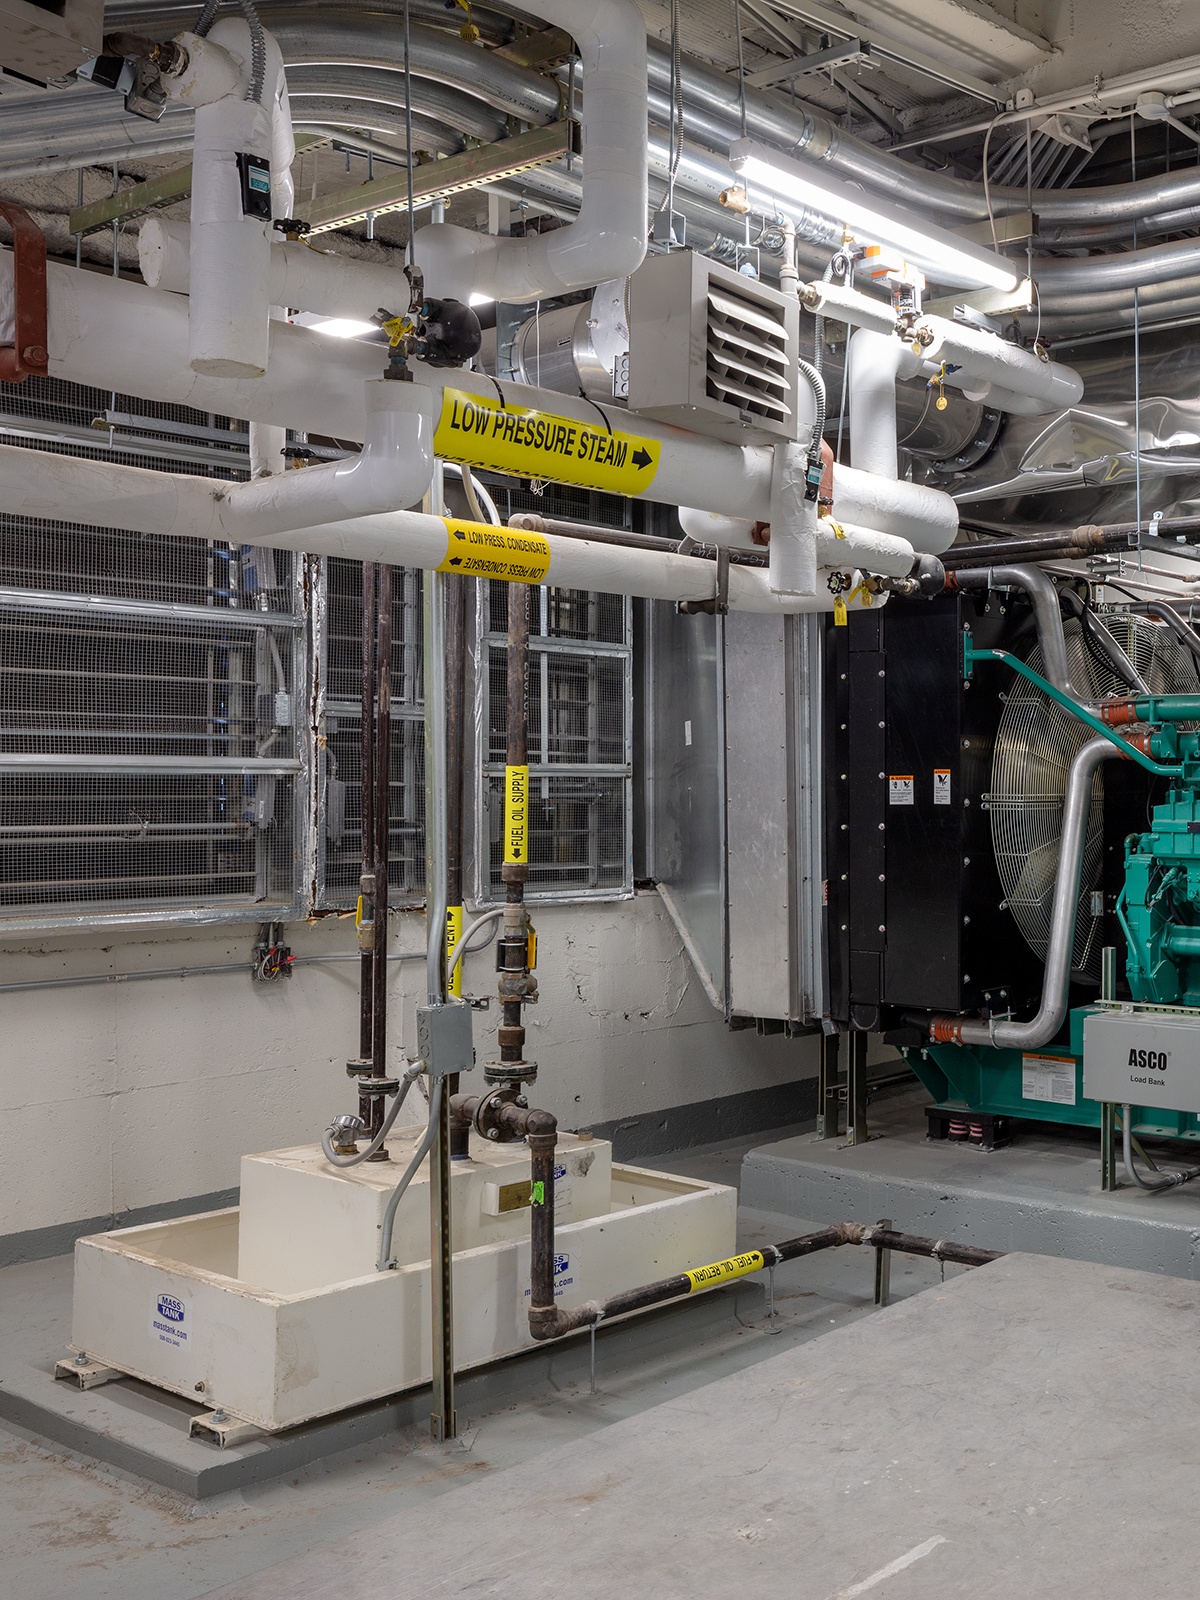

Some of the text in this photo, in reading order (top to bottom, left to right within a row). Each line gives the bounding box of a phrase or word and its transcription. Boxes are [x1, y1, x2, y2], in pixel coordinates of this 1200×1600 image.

[450, 400, 628, 468] LOW PRESSURE STEAM
[467, 531, 548, 554] LOW PRESS. CONDENSATE
[463, 558, 508, 574] CONDENSATE
[528, 567, 544, 579] LOW
[512, 770, 524, 847] FUEL OIL SUPPLY
[1128, 1048, 1168, 1071] ASCO
[1130, 1075, 1166, 1086] Load Bank
[692, 1254, 752, 1283] FUEL OIL RETURN
[162, 1296, 181, 1310] MASS
[162, 1306, 180, 1320] TANK
